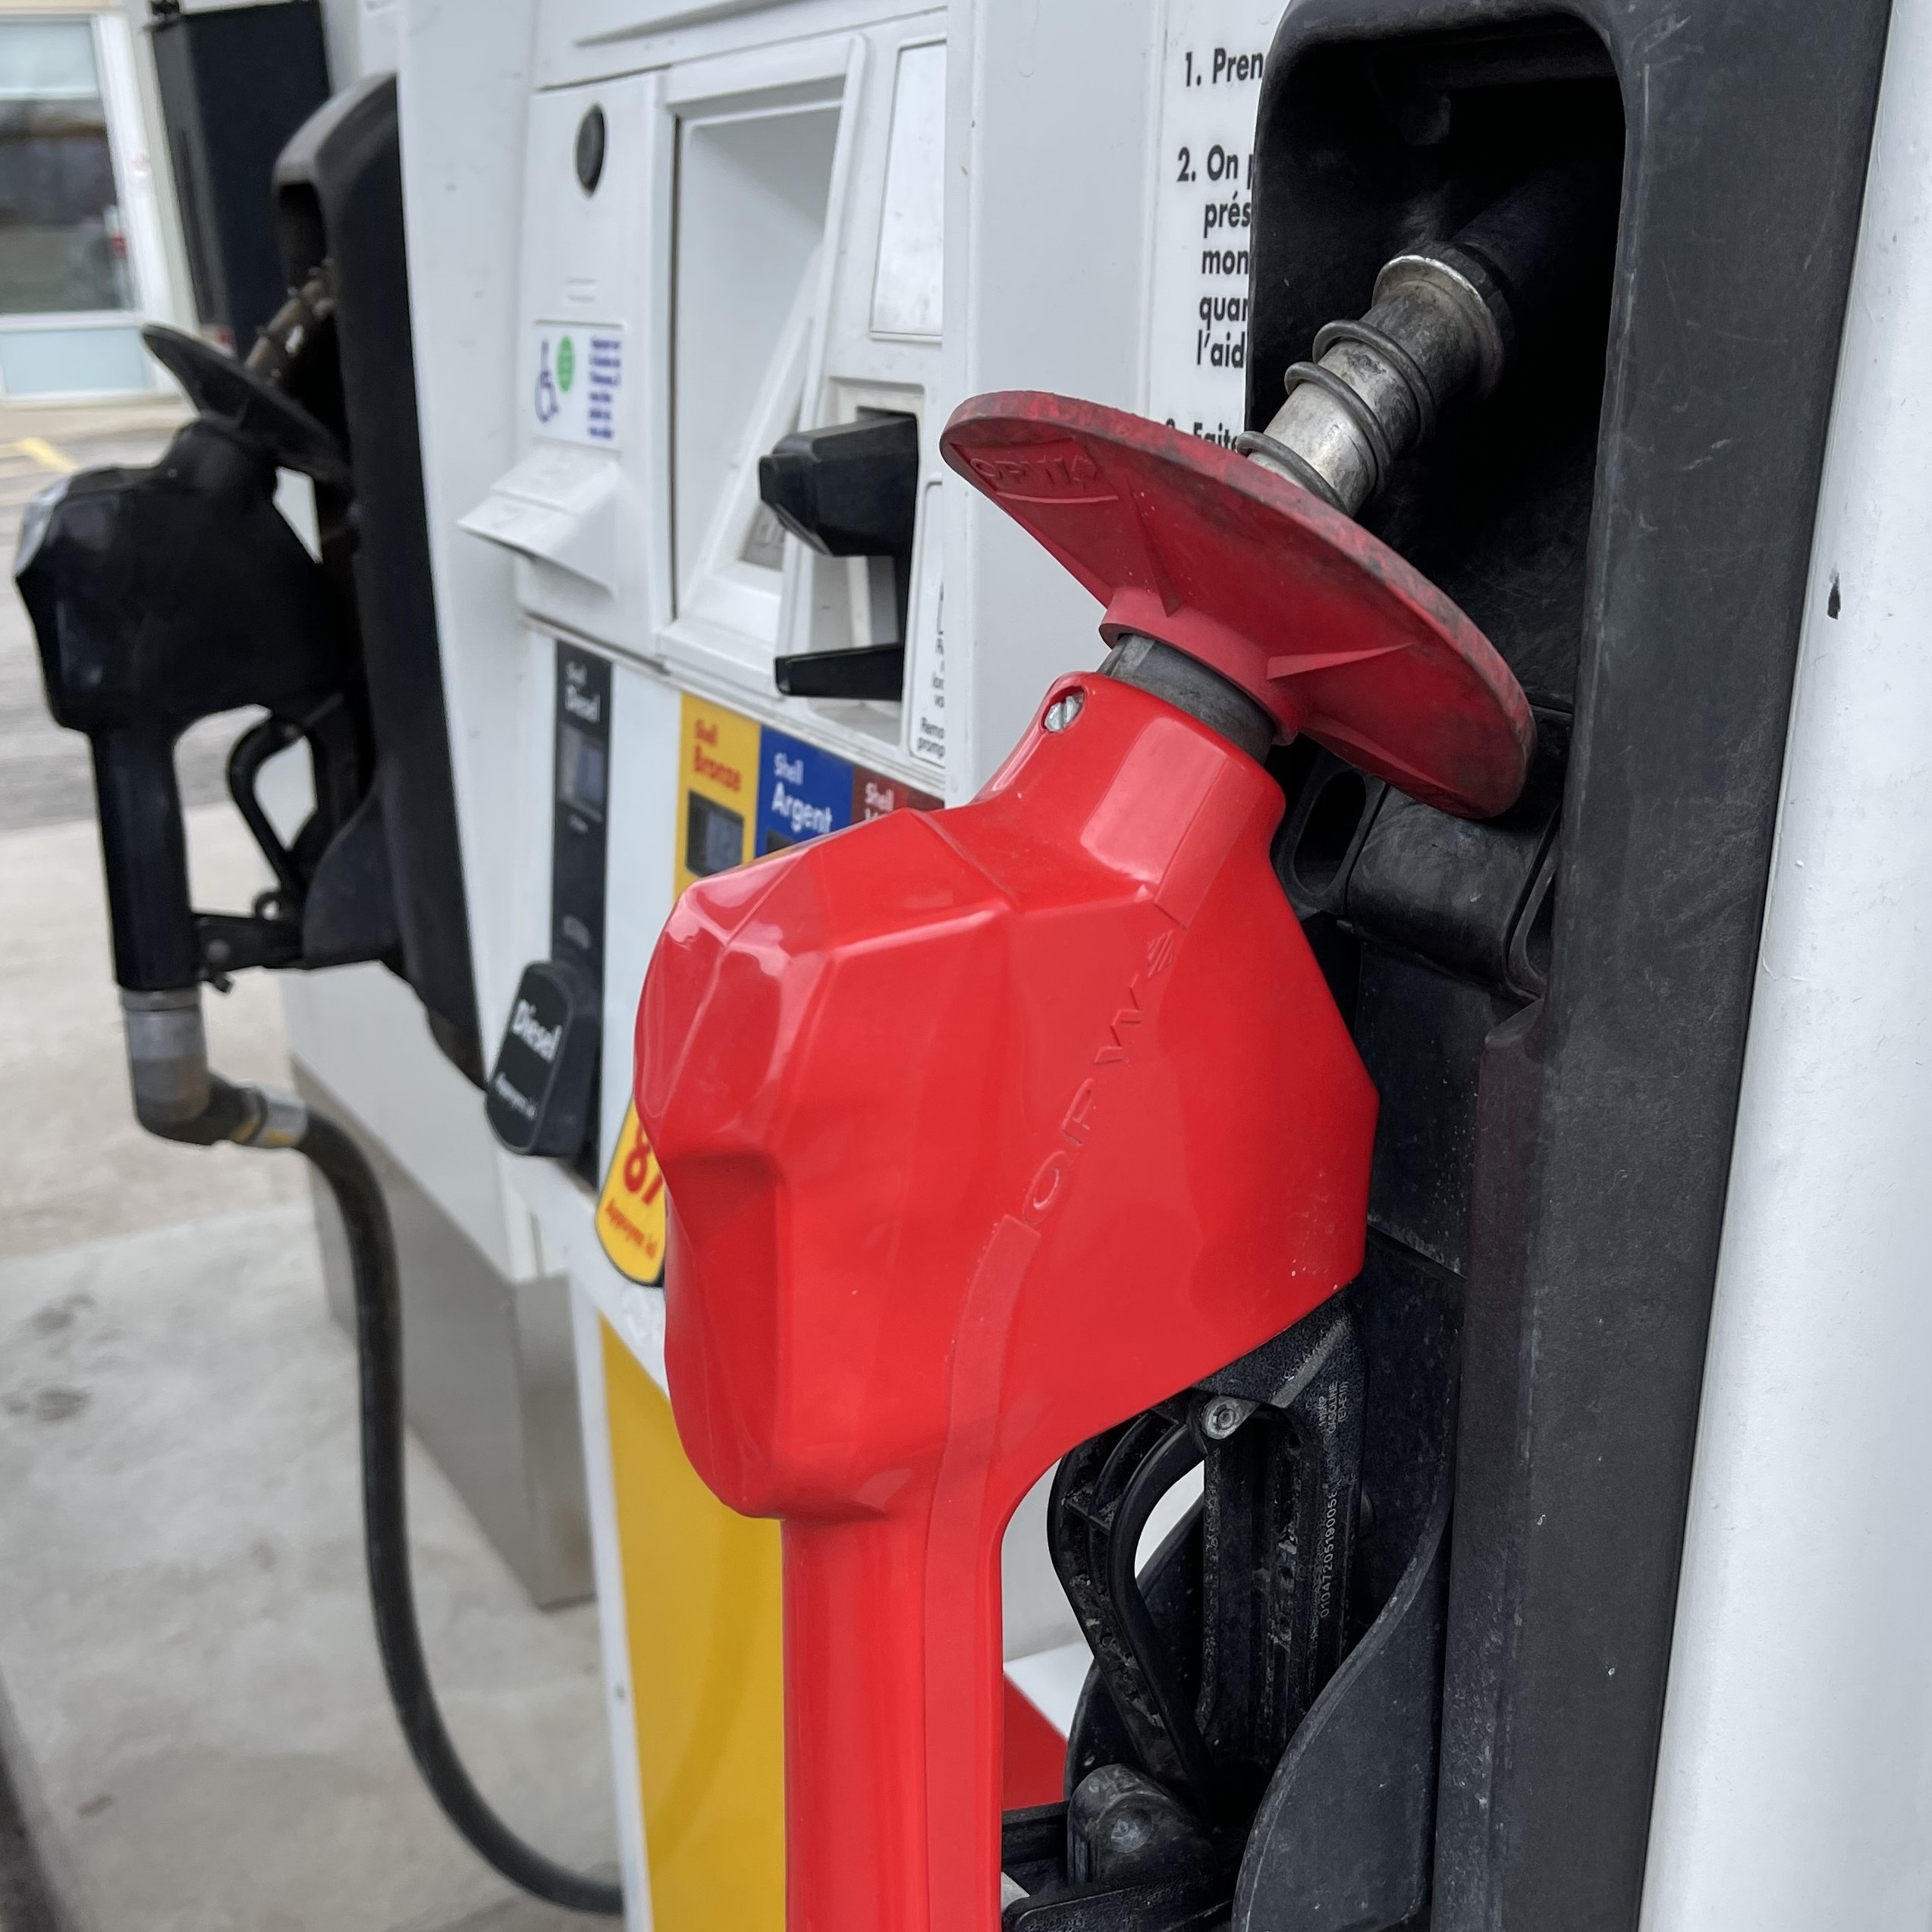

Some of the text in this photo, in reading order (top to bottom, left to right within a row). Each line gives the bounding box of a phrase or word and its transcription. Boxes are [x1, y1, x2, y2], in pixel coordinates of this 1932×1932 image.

[1185, 47, 1263, 87] 1. Pren
[1176, 146, 1196, 182] 2.
[1207, 144, 1239, 181] On
[1203, 190, 1251, 239] prés
[1202, 250, 1249, 275] mon
[774, 752, 804, 786] Shell
[772, 781, 832, 834] Argent
[865, 782, 894, 812] Shell
[512, 999, 563, 1063] Diesel
